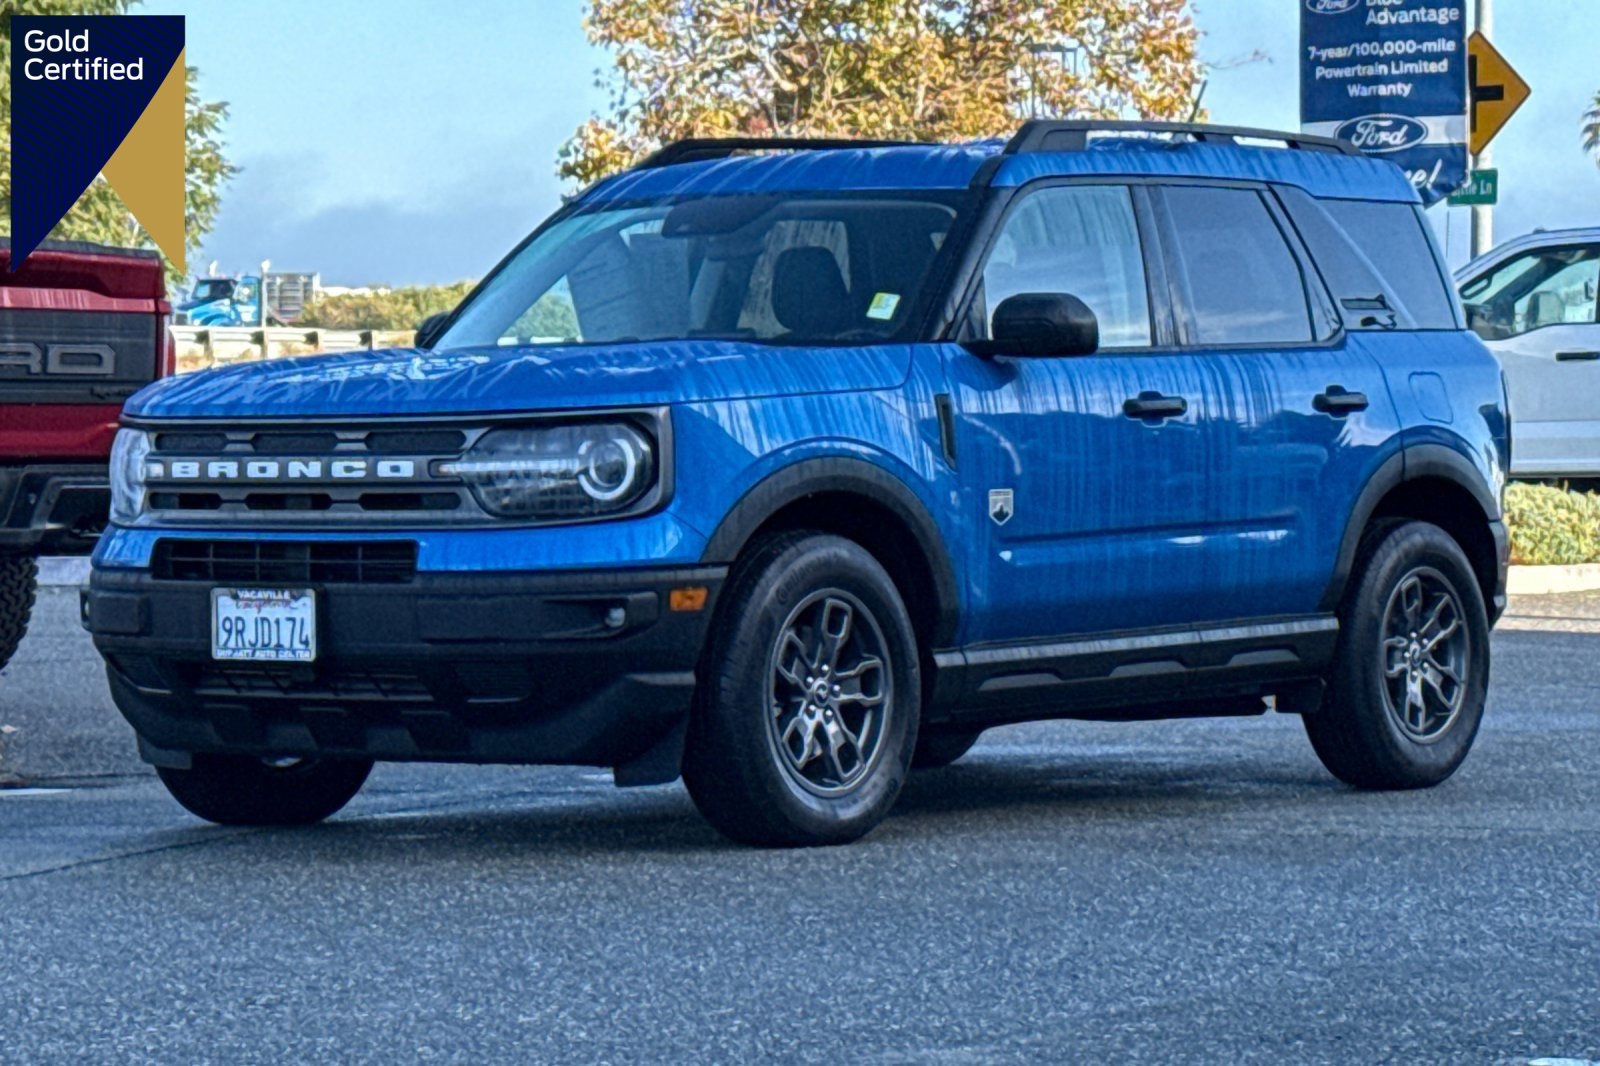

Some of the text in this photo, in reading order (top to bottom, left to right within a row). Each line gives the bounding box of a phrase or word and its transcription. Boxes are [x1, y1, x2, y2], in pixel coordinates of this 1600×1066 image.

[1365, 7, 1460, 26] Advantage
[1308, 38, 1456, 61] 7-year/100,000-mile
[1315, 59, 1448, 80] Powertrain Limited
[1347, 83, 1412, 98] Warranty
[1351, 119, 1409, 146] Ford
[171, 460, 415, 478] BRONCO
[221, 616, 310, 649] 9RJD174
